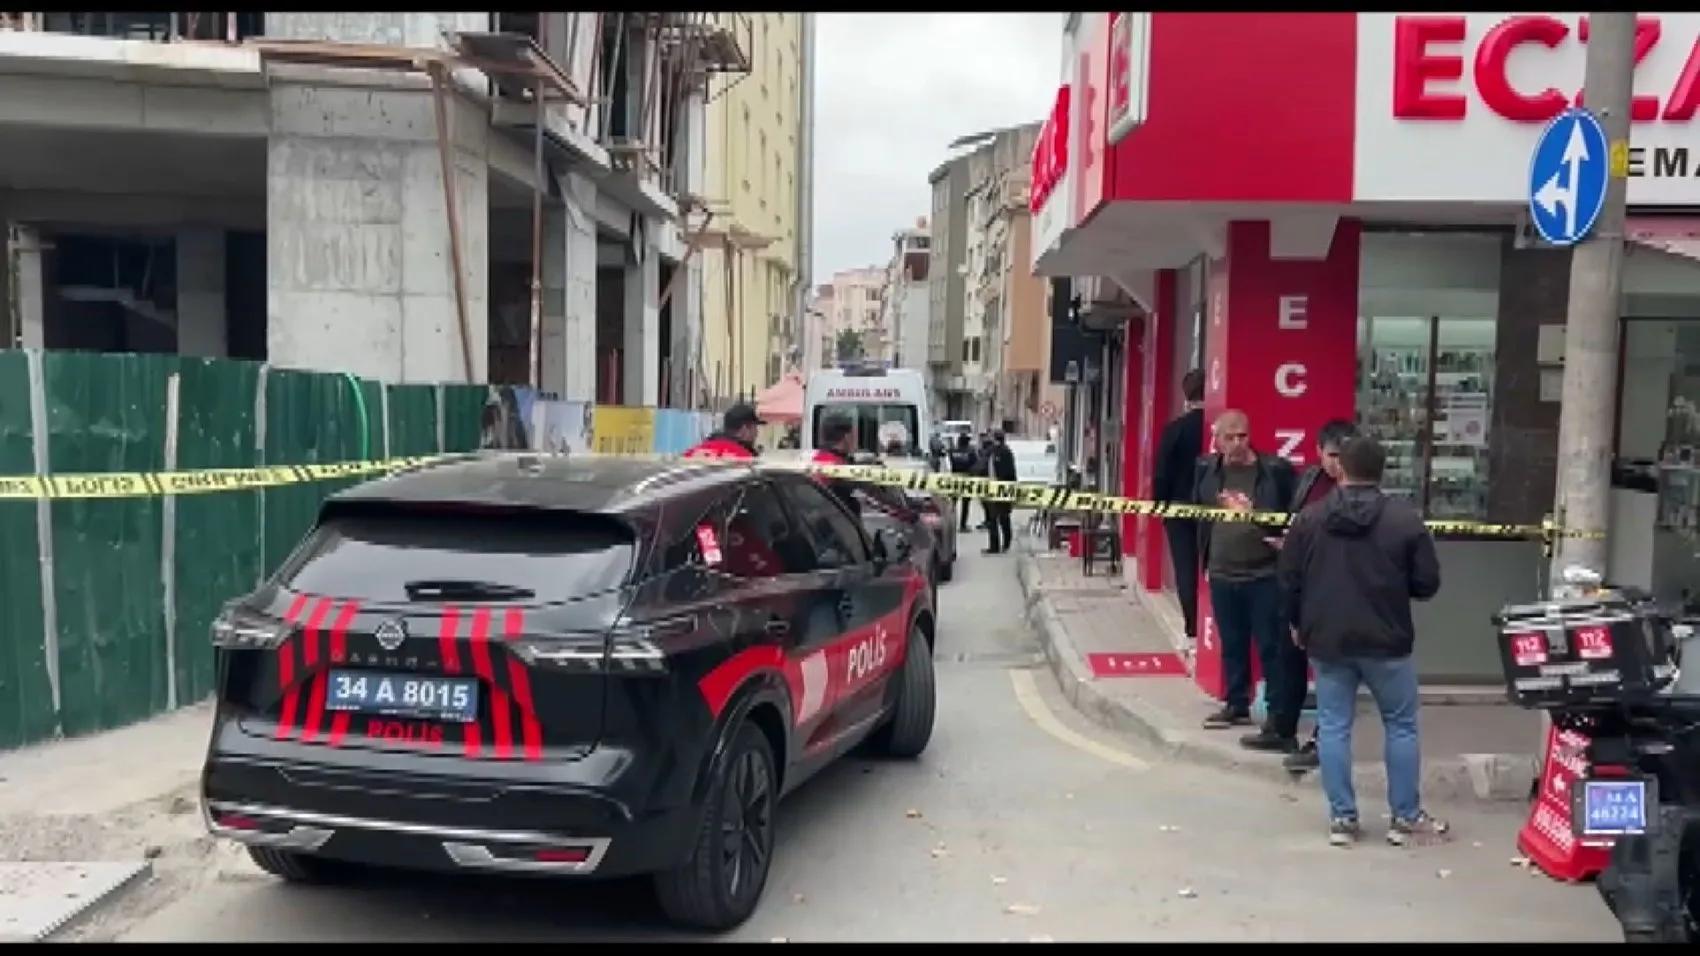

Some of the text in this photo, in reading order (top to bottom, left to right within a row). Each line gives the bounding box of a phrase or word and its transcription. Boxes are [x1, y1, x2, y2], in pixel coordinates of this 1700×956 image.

[1628, 147, 1700, 177] EM
[336, 676, 469, 709] 34 A 8015
